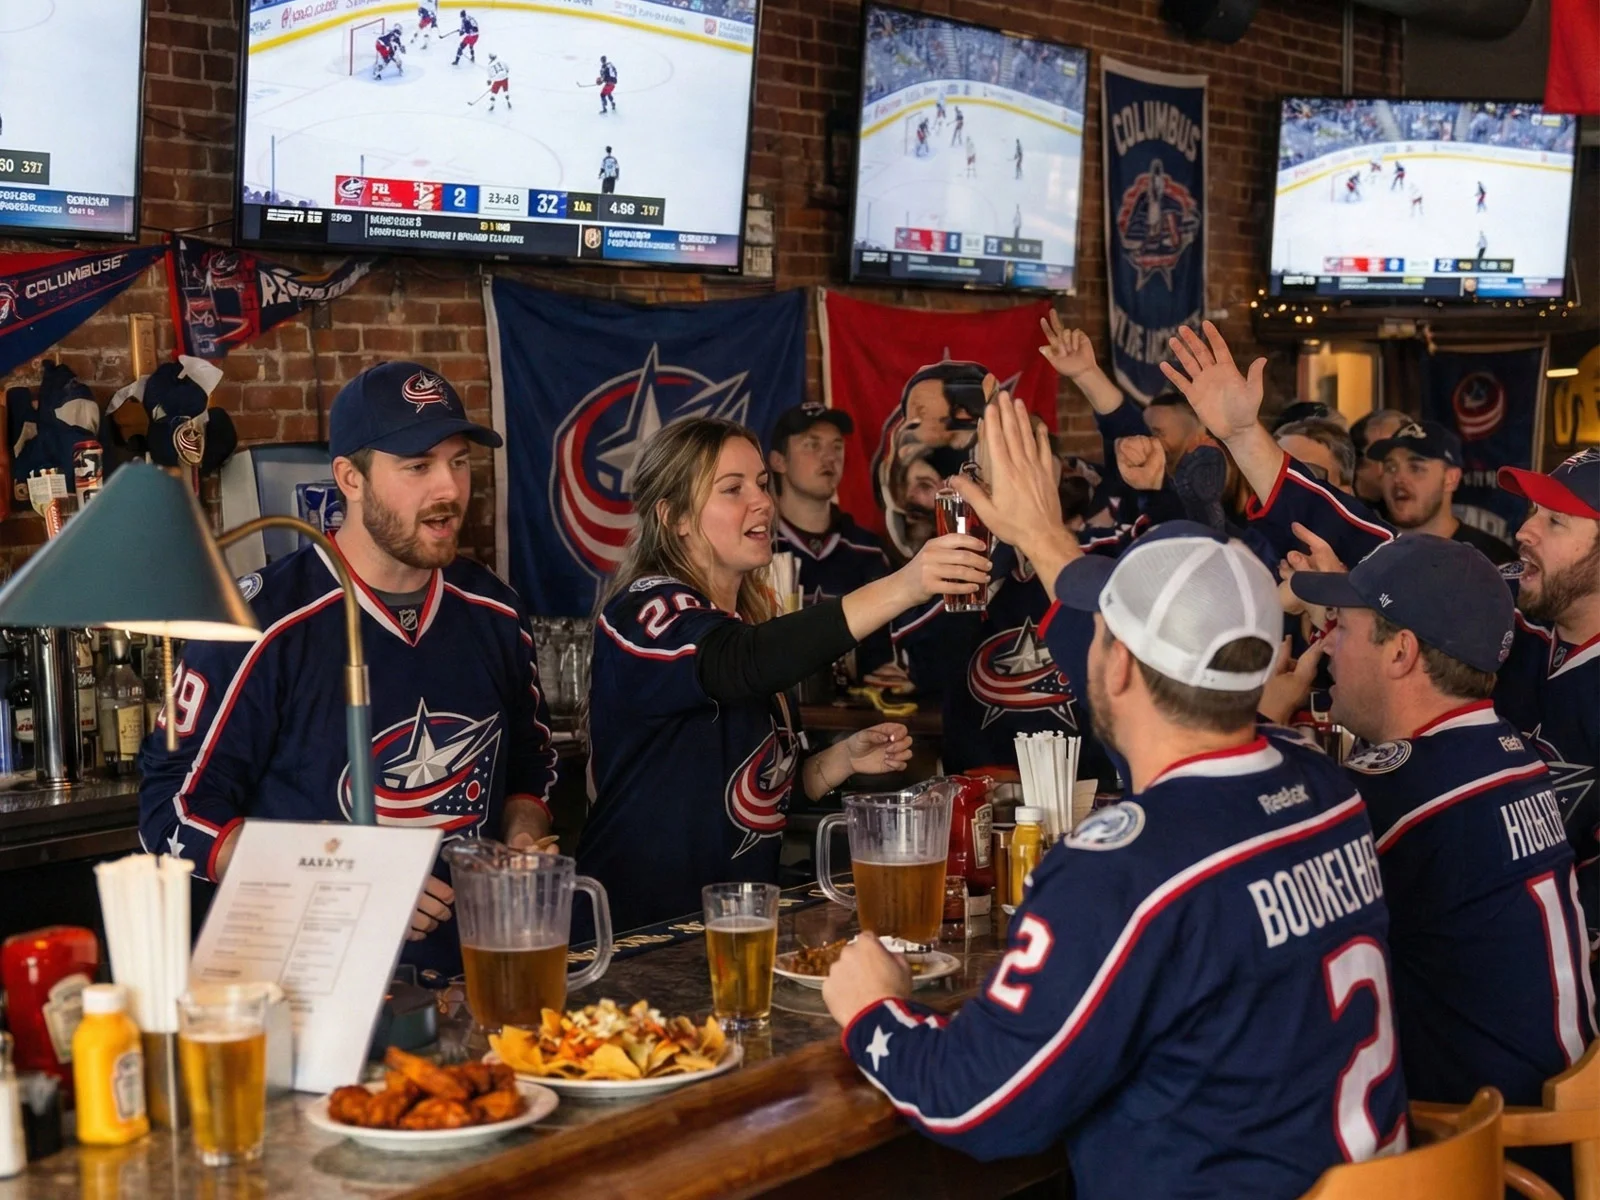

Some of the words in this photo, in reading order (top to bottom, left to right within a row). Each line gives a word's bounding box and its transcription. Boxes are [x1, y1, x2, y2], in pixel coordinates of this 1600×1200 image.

[1112, 100, 1201, 162] COLUMBUS
[454, 188, 466, 207] 2
[537, 193, 559, 213] 32
[987, 912, 1055, 1014] 2
[1323, 936, 1408, 1163] 2
